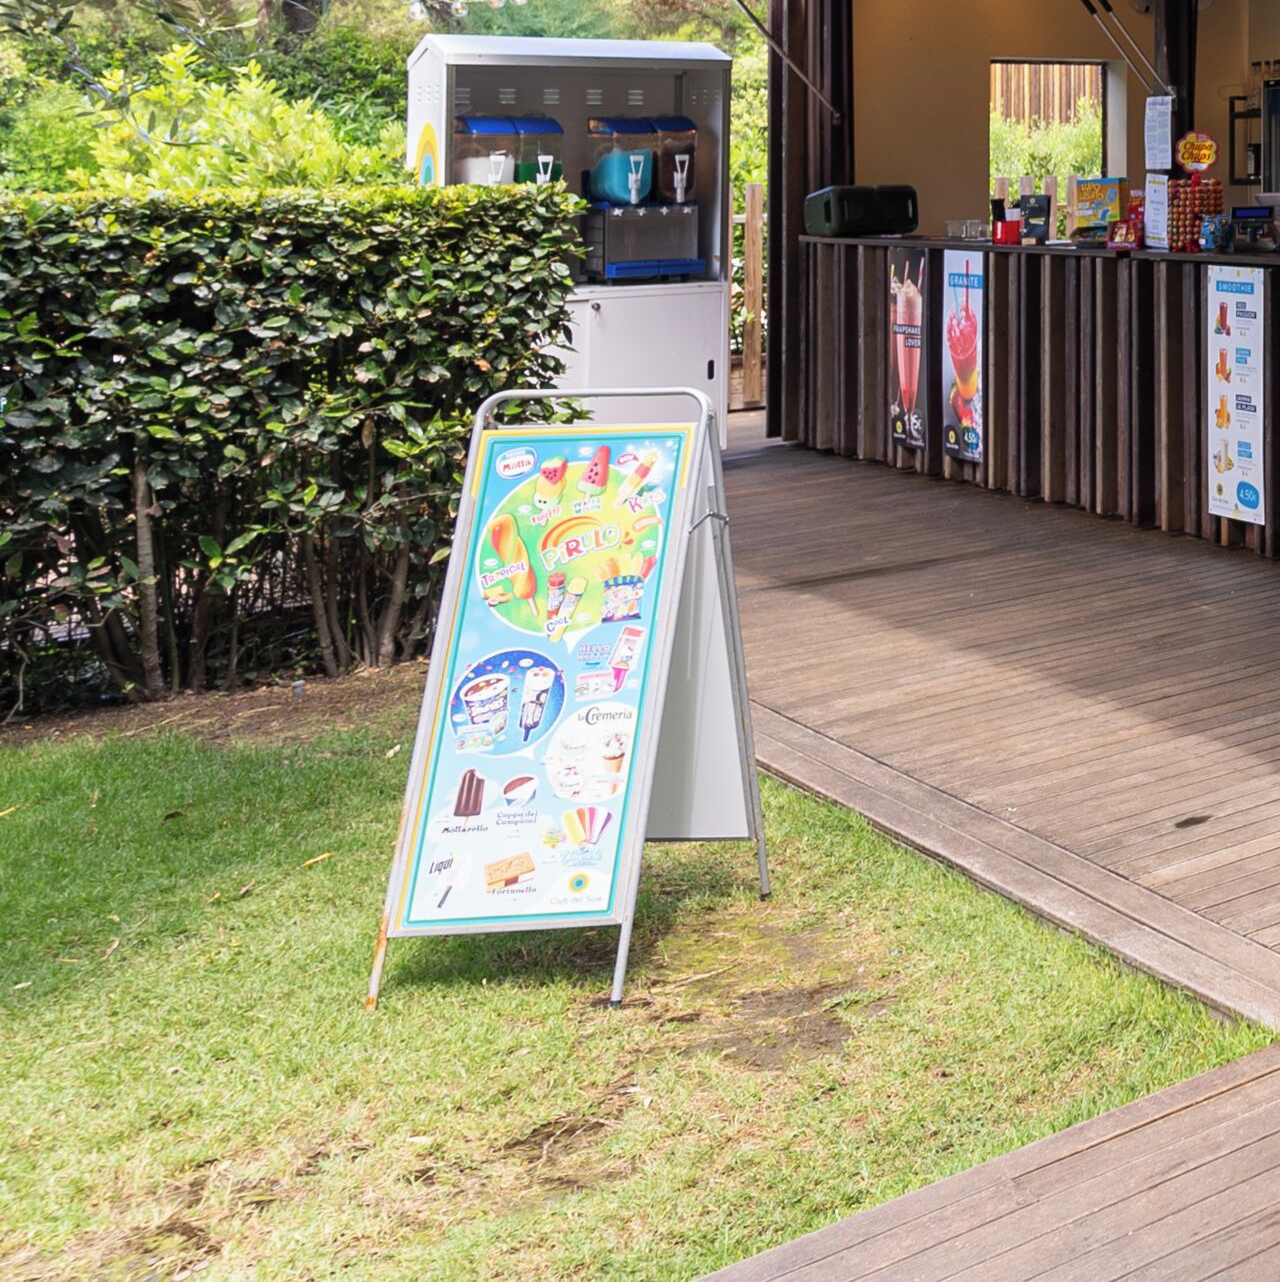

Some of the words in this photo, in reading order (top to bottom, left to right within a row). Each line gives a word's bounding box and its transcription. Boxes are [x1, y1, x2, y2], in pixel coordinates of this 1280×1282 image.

[1183, 140, 1213, 151] Chupa
[1182, 150, 1211, 161] Chups
[481, 562, 526, 587] TROPICAL
